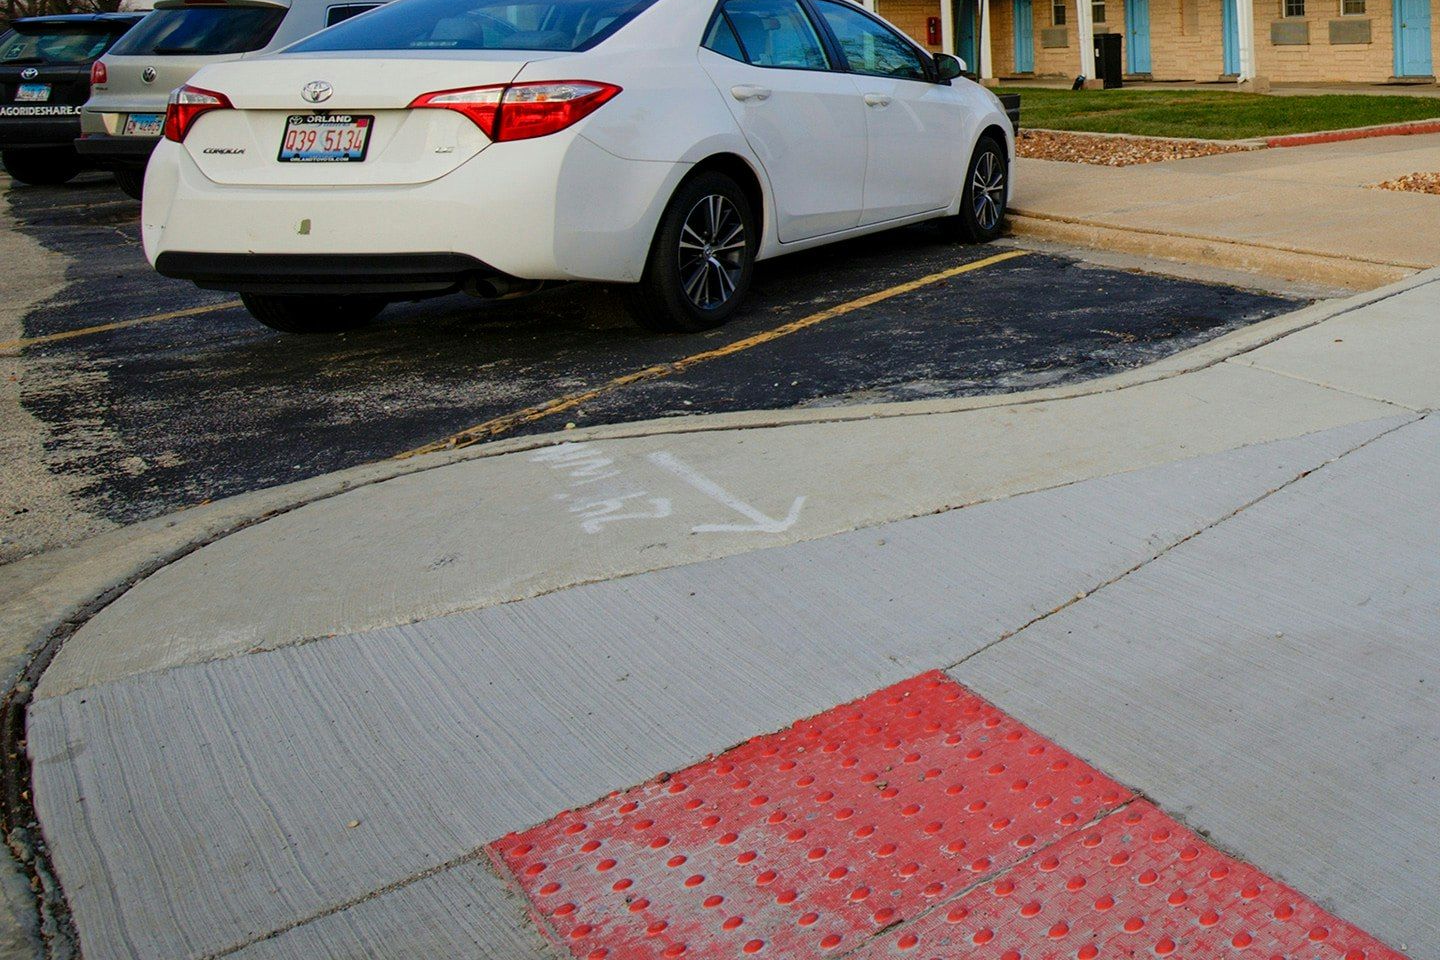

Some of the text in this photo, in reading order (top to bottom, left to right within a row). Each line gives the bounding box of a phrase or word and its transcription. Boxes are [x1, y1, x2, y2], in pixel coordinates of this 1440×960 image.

[306, 115, 352, 123] ORLAND
[285, 130, 363, 152] Q39 5134
